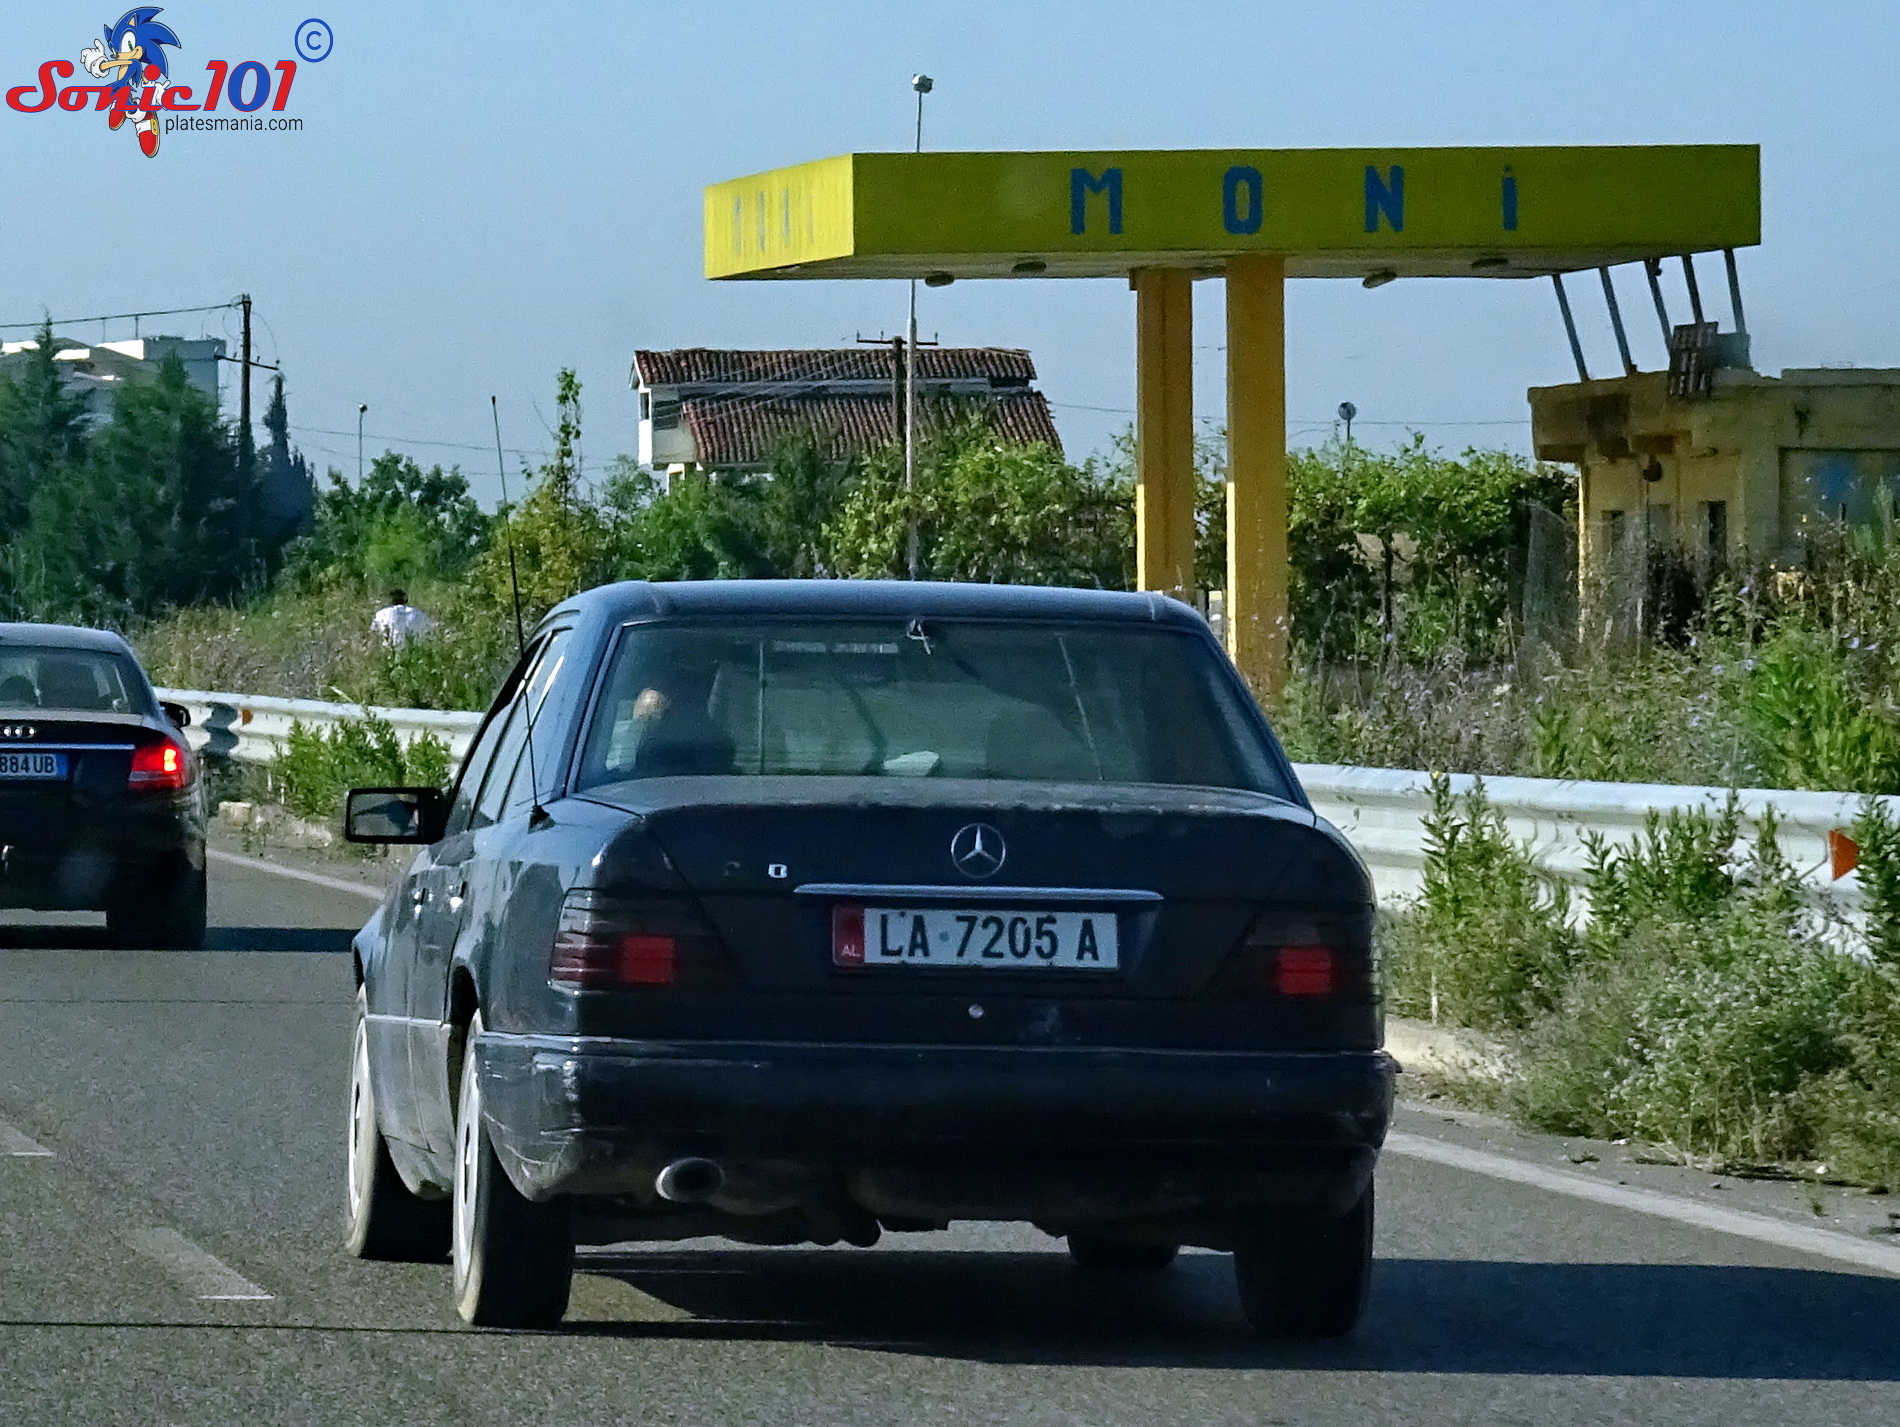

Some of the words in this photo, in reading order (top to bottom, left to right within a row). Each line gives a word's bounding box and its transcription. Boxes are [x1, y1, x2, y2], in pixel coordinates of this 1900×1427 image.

[842, 945, 860, 958] AL
[880, 914, 930, 957] LA
[956, 914, 1058, 960] 7205
[1076, 918, 1099, 961] A
